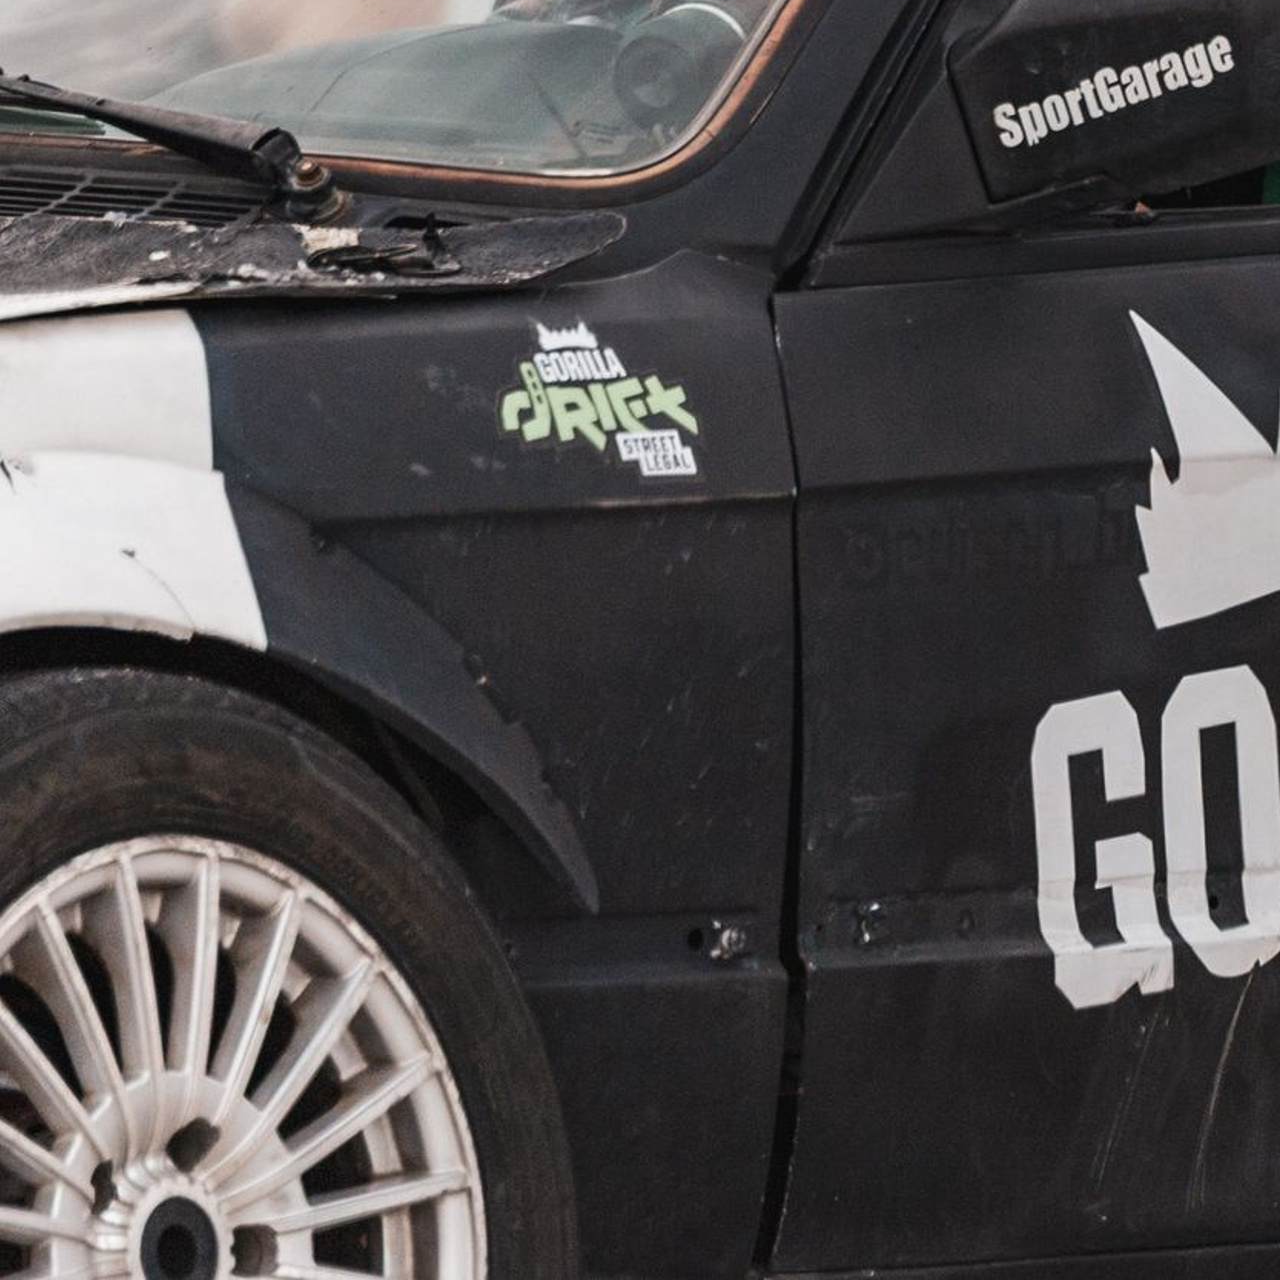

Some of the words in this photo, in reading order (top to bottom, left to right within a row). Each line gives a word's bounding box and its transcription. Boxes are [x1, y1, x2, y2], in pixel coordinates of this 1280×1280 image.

[993, 35, 1235, 148] SportGarage
[533, 347, 627, 383] GORILLA
[502, 361, 698, 452] DRIFT
[622, 435, 676, 455] STREET
[643, 453, 691, 471] LEGAL
